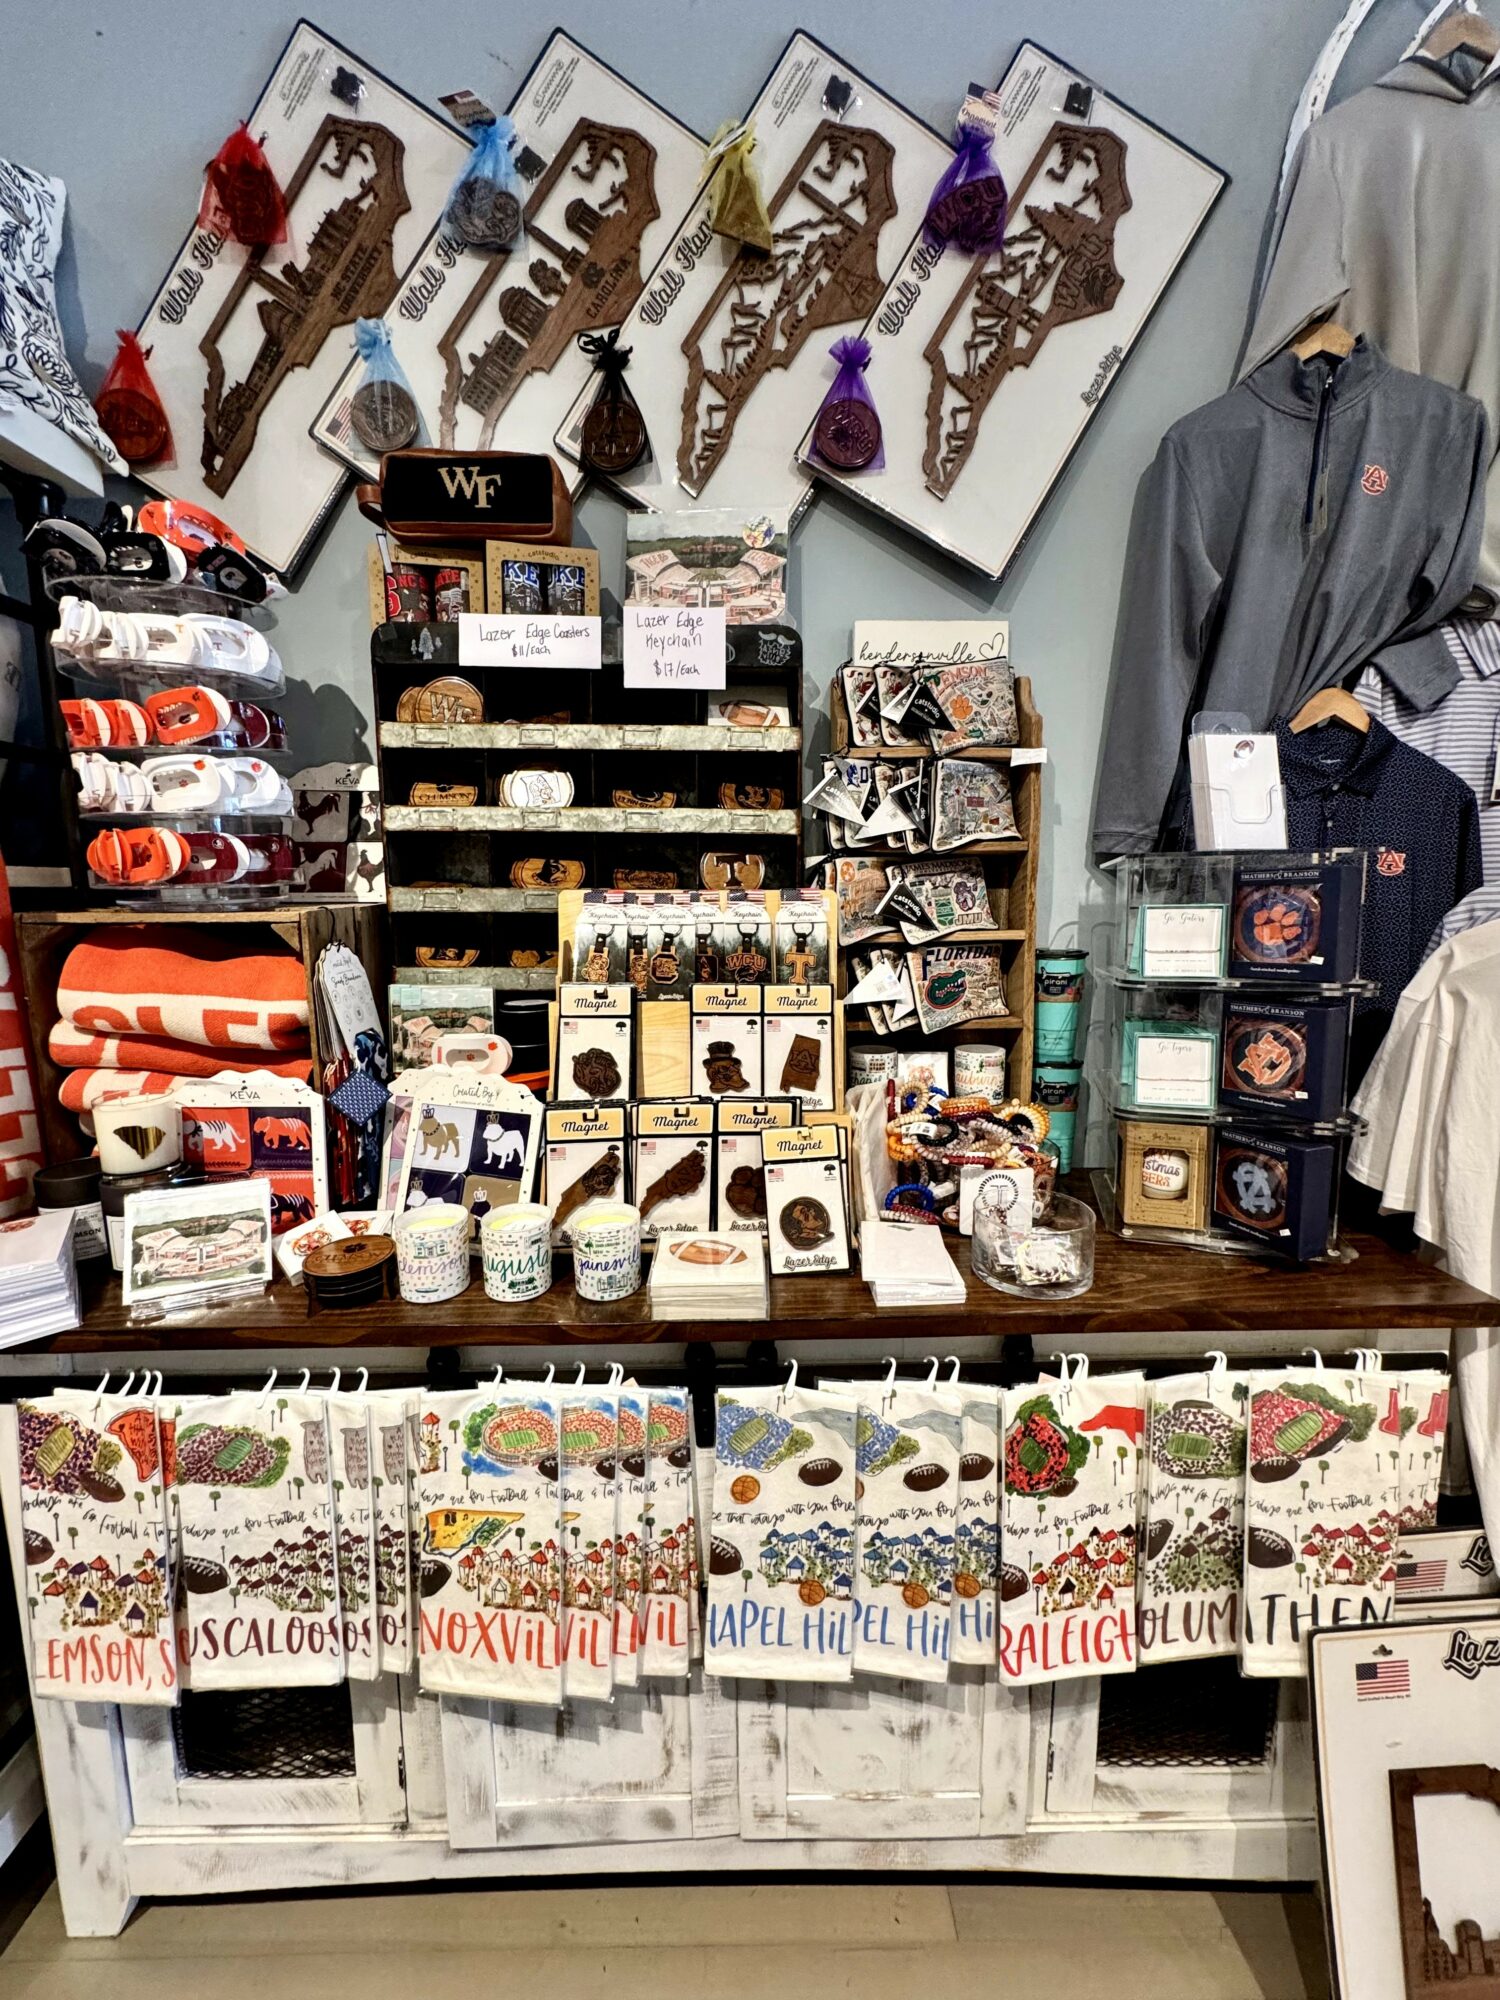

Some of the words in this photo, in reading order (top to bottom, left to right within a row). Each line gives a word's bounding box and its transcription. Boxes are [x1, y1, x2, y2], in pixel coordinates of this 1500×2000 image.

[159, 266, 203, 324] Wall
[400, 264, 445, 322] Wall
[586, 257, 631, 318] CAROLINA
[638, 268, 685, 327] Wall
[877, 278, 921, 337] Wall
[437, 466, 502, 509] WF
[637, 613, 670, 629] Lazer
[676, 611, 705, 636] Edge
[479, 623, 516, 642] Lazer
[525, 622, 551, 645] Edge
[553, 623, 591, 640] Coasters
[645, 632, 703, 657] Keychain
[955, 912, 983, 926] JMU
[726, 953, 767, 972] WCU
[574, 997, 617, 1012] Magnet
[705, 995, 748, 1010] Magnet
[776, 996, 819, 1010] Magnet
[230, 1090, 261, 1100] KEVA
[453, 1084, 480, 1098] Created
[561, 1119, 609, 1135] Magnet
[652, 1114, 699, 1130] Magnet
[732, 1112, 778, 1128] Magnet
[776, 1139, 824, 1155] Magnet
[783, 1255, 813, 1270] Lazer
[812, 1254, 838, 1269] Edge
